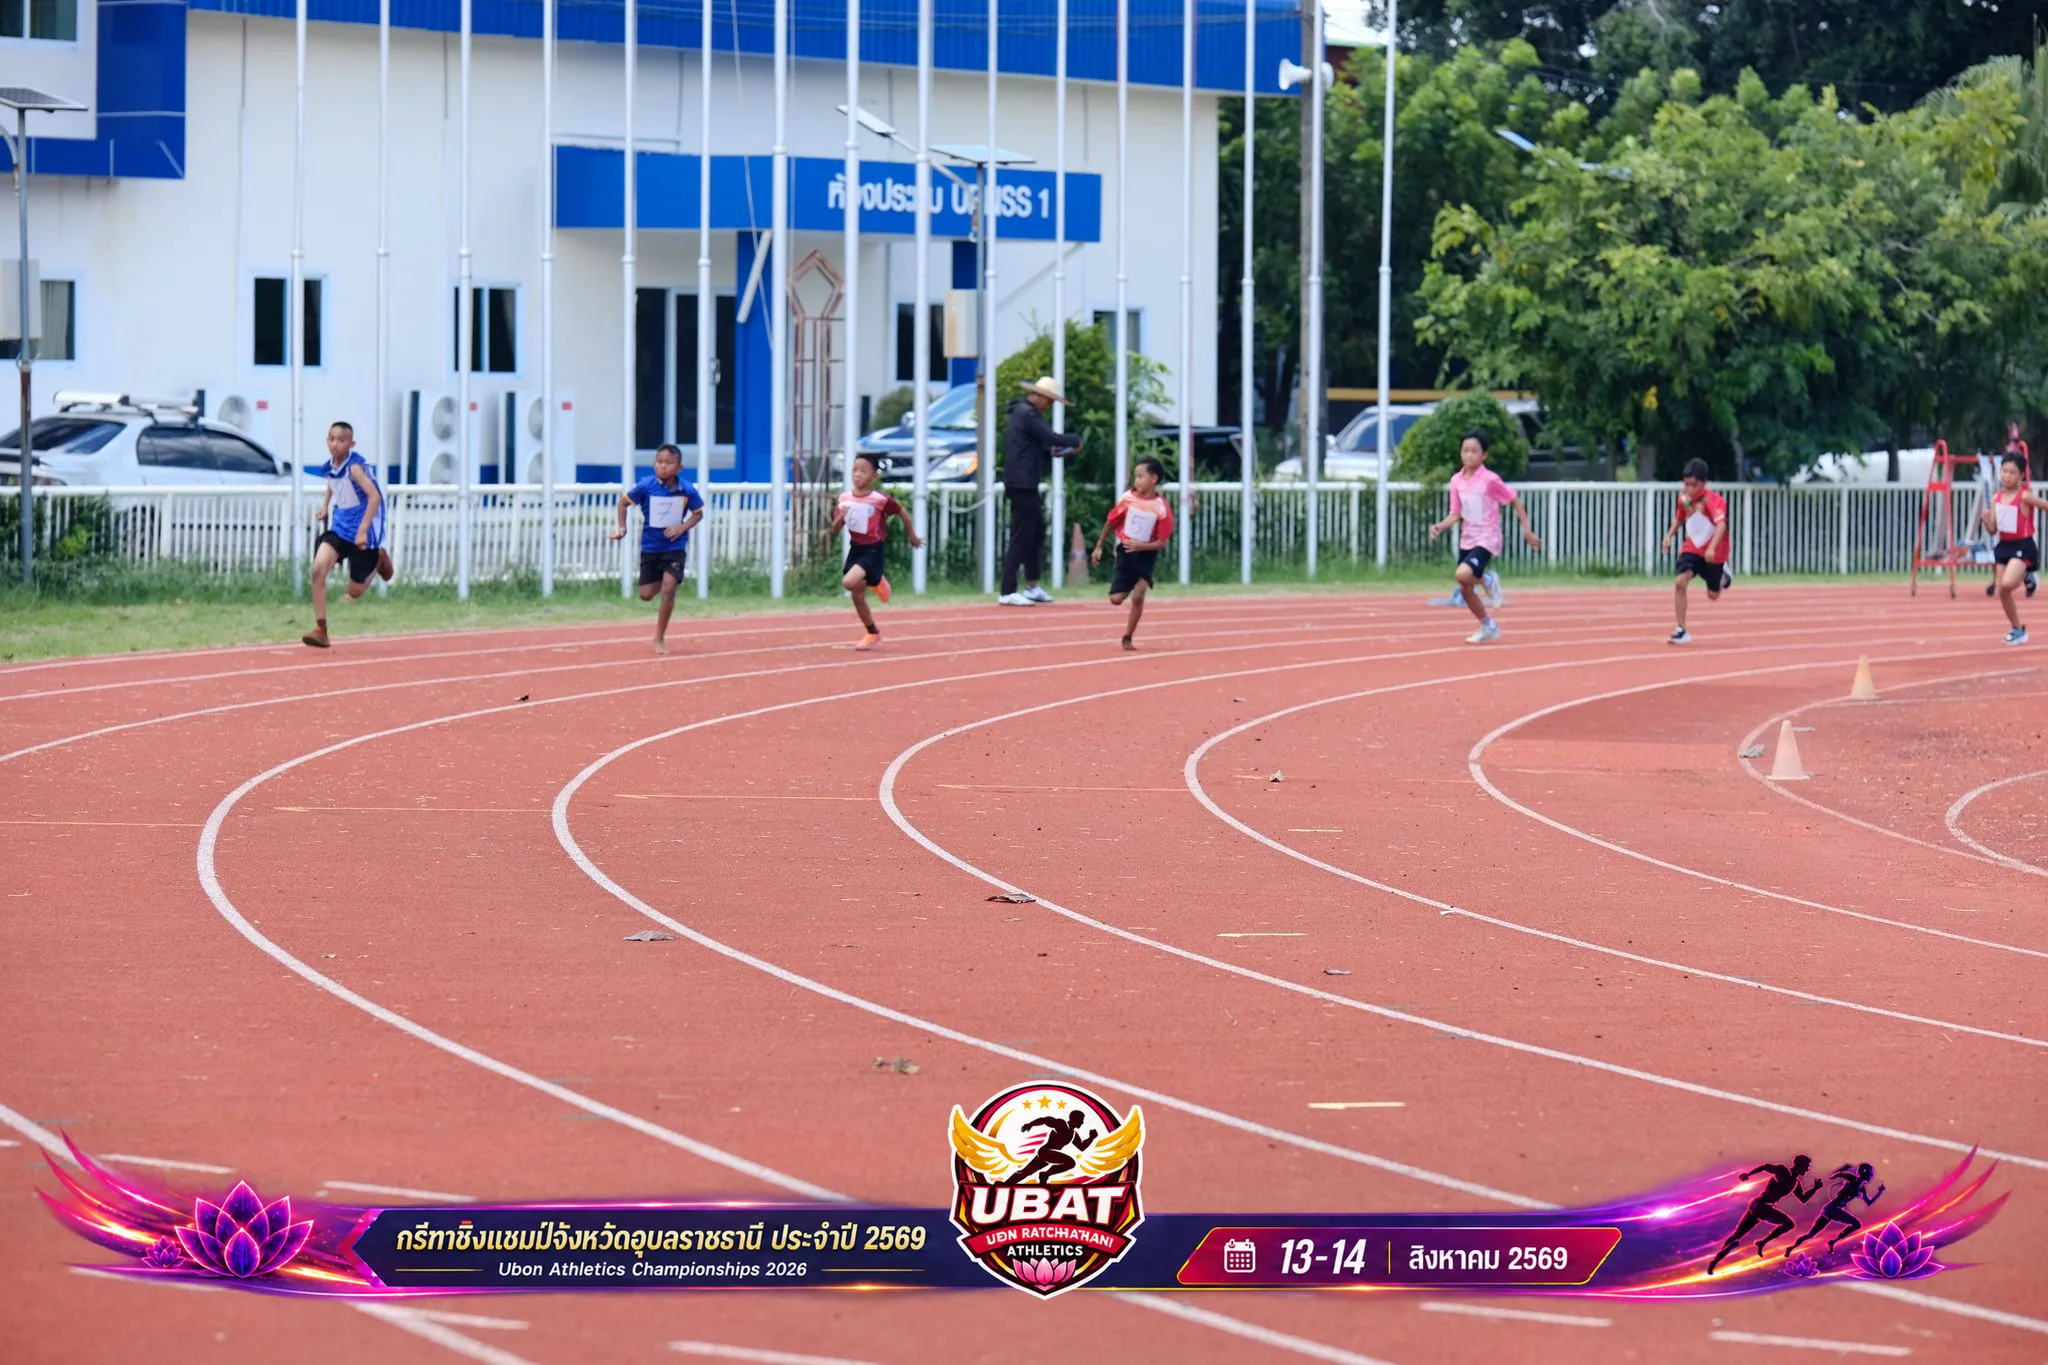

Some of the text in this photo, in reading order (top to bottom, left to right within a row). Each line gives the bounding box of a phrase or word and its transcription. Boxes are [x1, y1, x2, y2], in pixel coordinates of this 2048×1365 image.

[1037, 187, 1050, 219] 1
[657, 501, 673, 522] 7
[1131, 514, 1145, 534] 5
